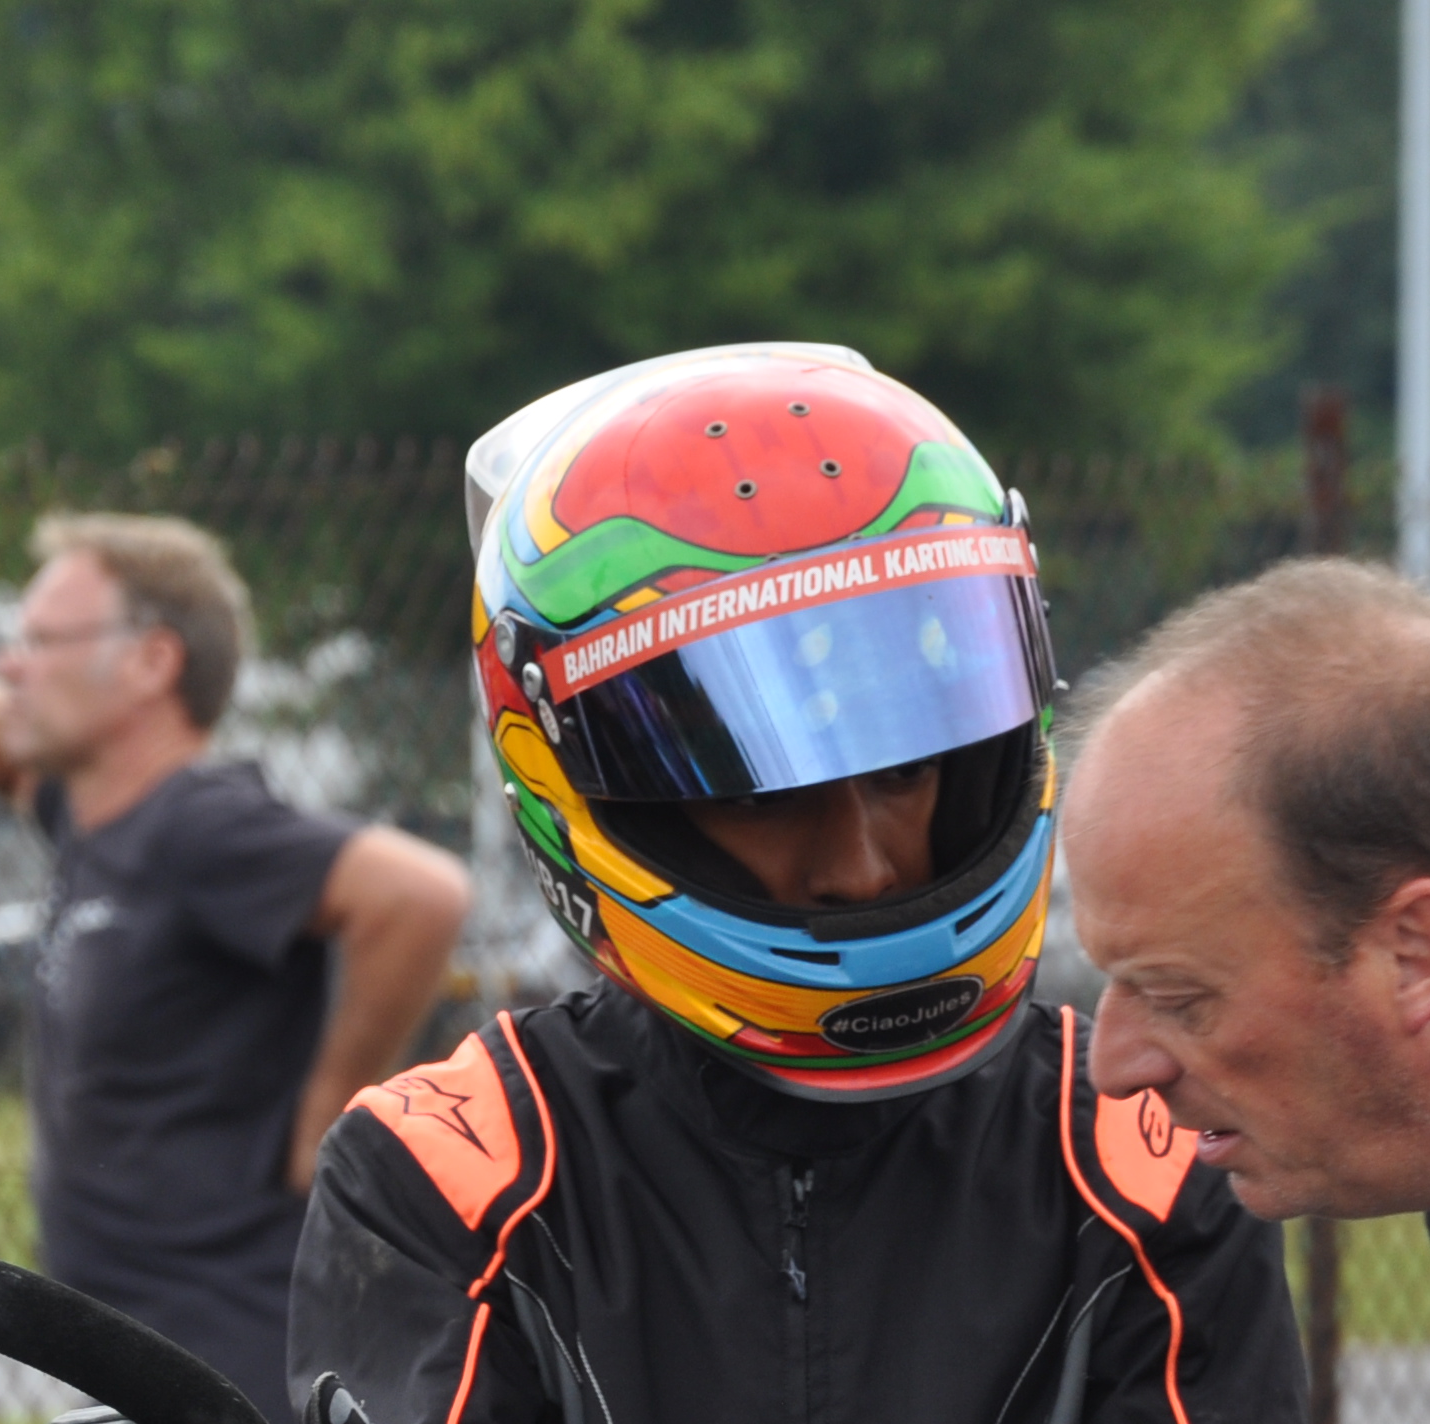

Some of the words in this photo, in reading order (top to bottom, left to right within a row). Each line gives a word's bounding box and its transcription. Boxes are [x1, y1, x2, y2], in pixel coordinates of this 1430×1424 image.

[563, 616, 654, 685] BAHRAIN
[658, 556, 879, 642] INTERNATIONAL
[884, 536, 980, 579] KARTING
[831, 991, 972, 1034] #CiaoJules
